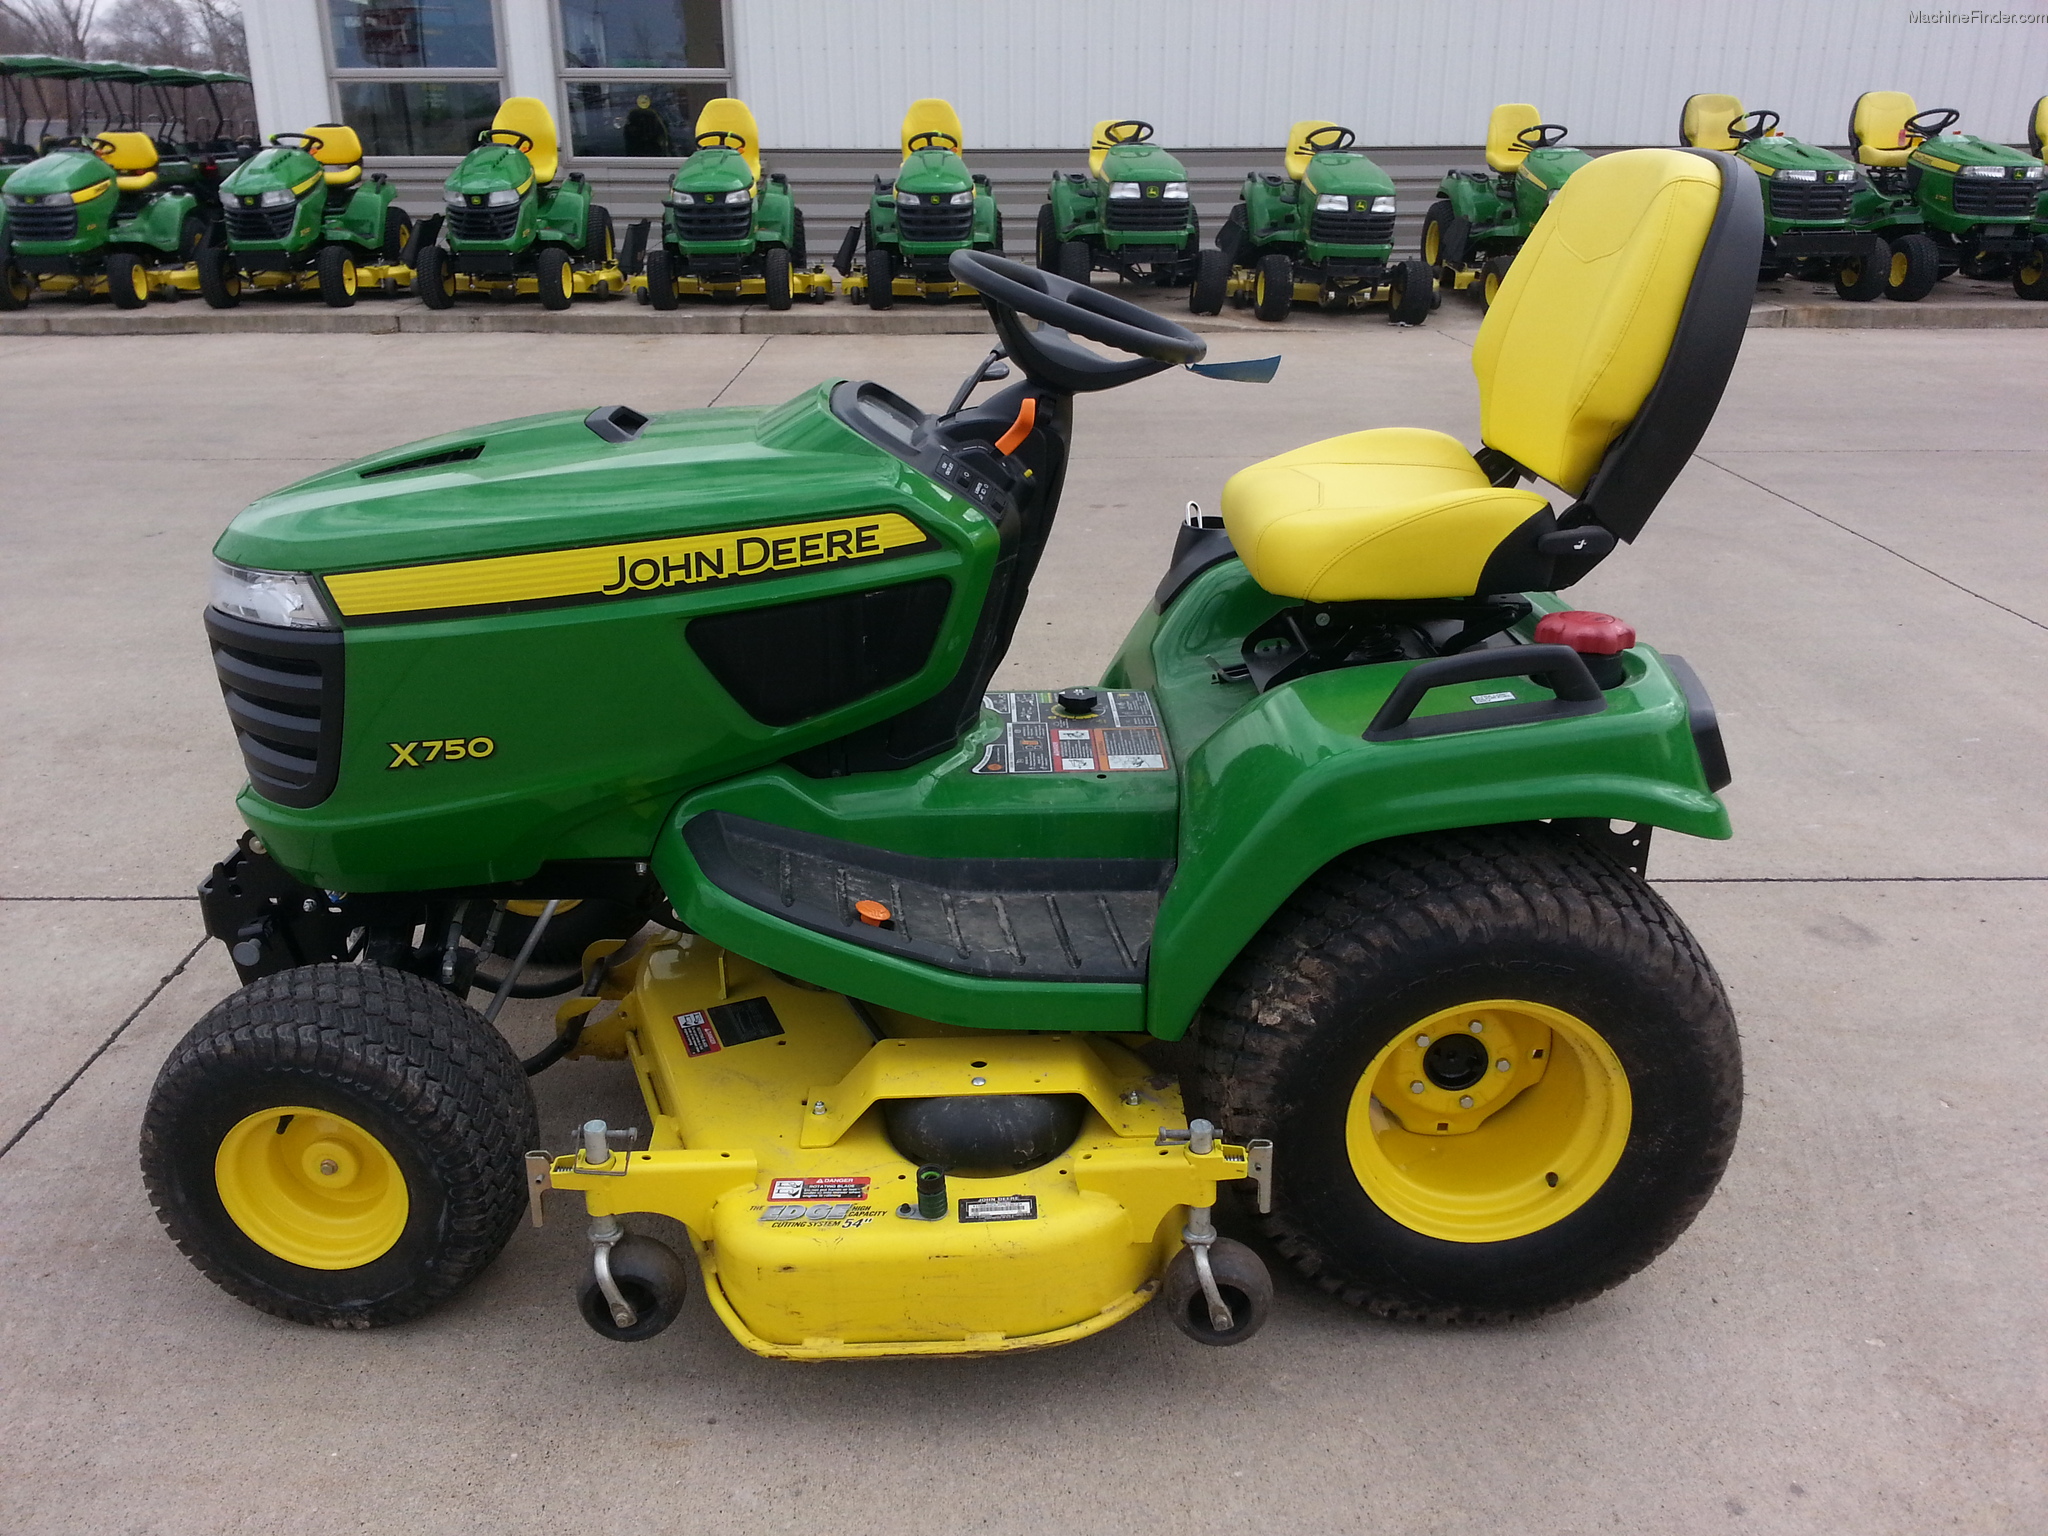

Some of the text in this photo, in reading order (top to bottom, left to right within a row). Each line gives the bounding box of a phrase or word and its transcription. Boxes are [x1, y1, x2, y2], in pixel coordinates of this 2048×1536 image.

[602, 524, 882, 592] JOHN DEERE
[387, 737, 495, 768] X750
[758, 1204, 852, 1221] EDGE
[808, 1220, 841, 1228] SYSTEM
[841, 1218, 873, 1229] 54"
